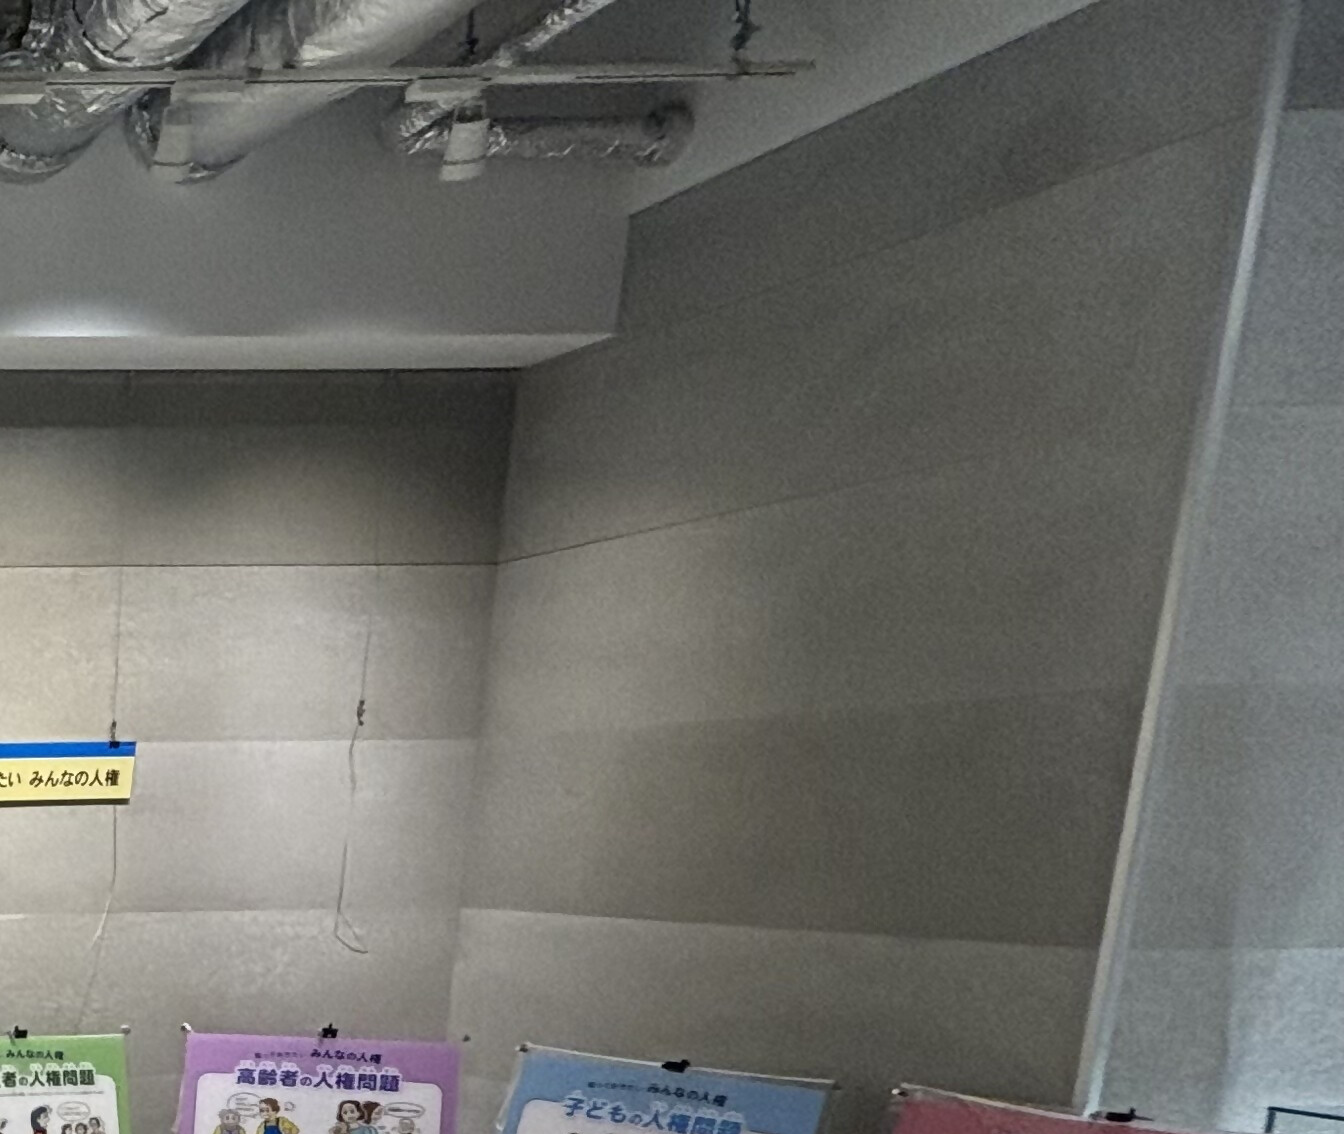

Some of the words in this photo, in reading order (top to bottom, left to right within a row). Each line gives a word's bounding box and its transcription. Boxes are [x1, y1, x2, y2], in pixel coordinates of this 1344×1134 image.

[29, 769, 121, 788] みんなの人権
[6, 1050, 64, 1061] みんなの人権
[310, 1048, 383, 1065] みんなの人権
[236, 1067, 401, 1092] 高齢者の人権問題
[646, 1082, 728, 1107] みんなの人権
